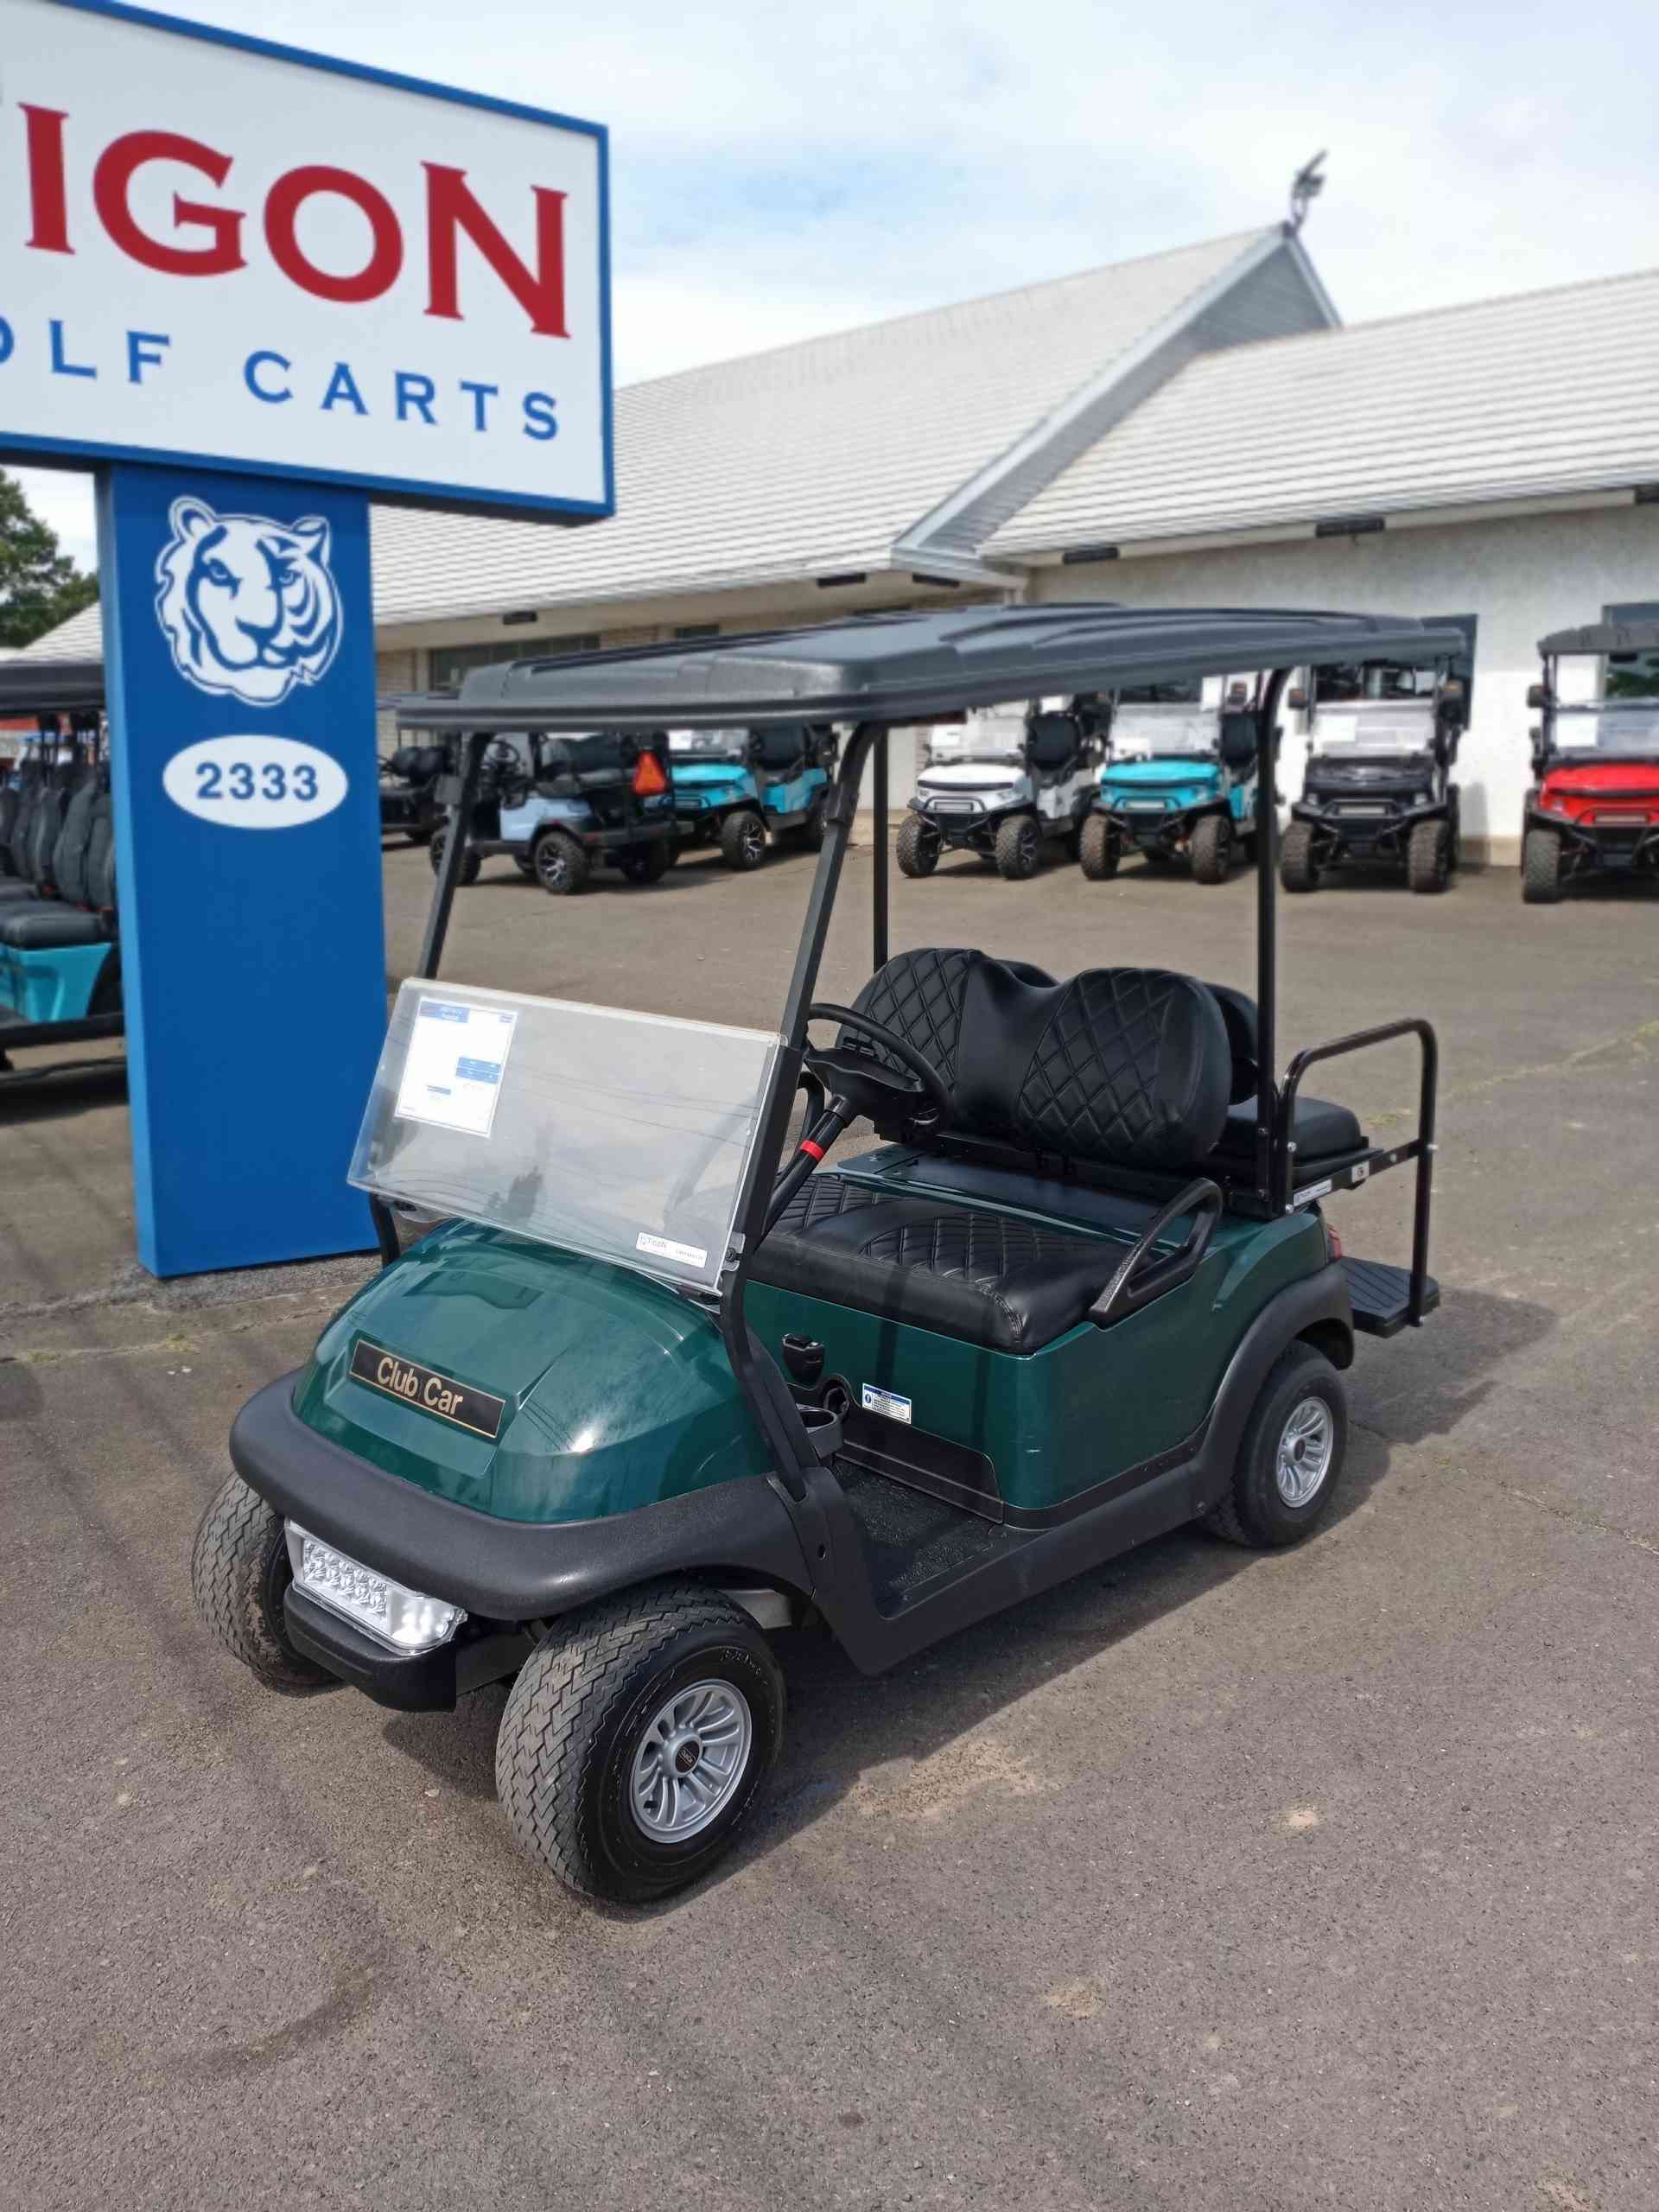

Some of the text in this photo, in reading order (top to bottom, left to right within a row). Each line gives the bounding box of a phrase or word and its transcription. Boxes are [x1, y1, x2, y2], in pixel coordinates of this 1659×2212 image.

[17, 101, 570, 339] IGON
[0, 315, 559, 442] LF CARTS
[195, 761, 319, 802] 2333
[378, 1357, 463, 1415] Club Car
